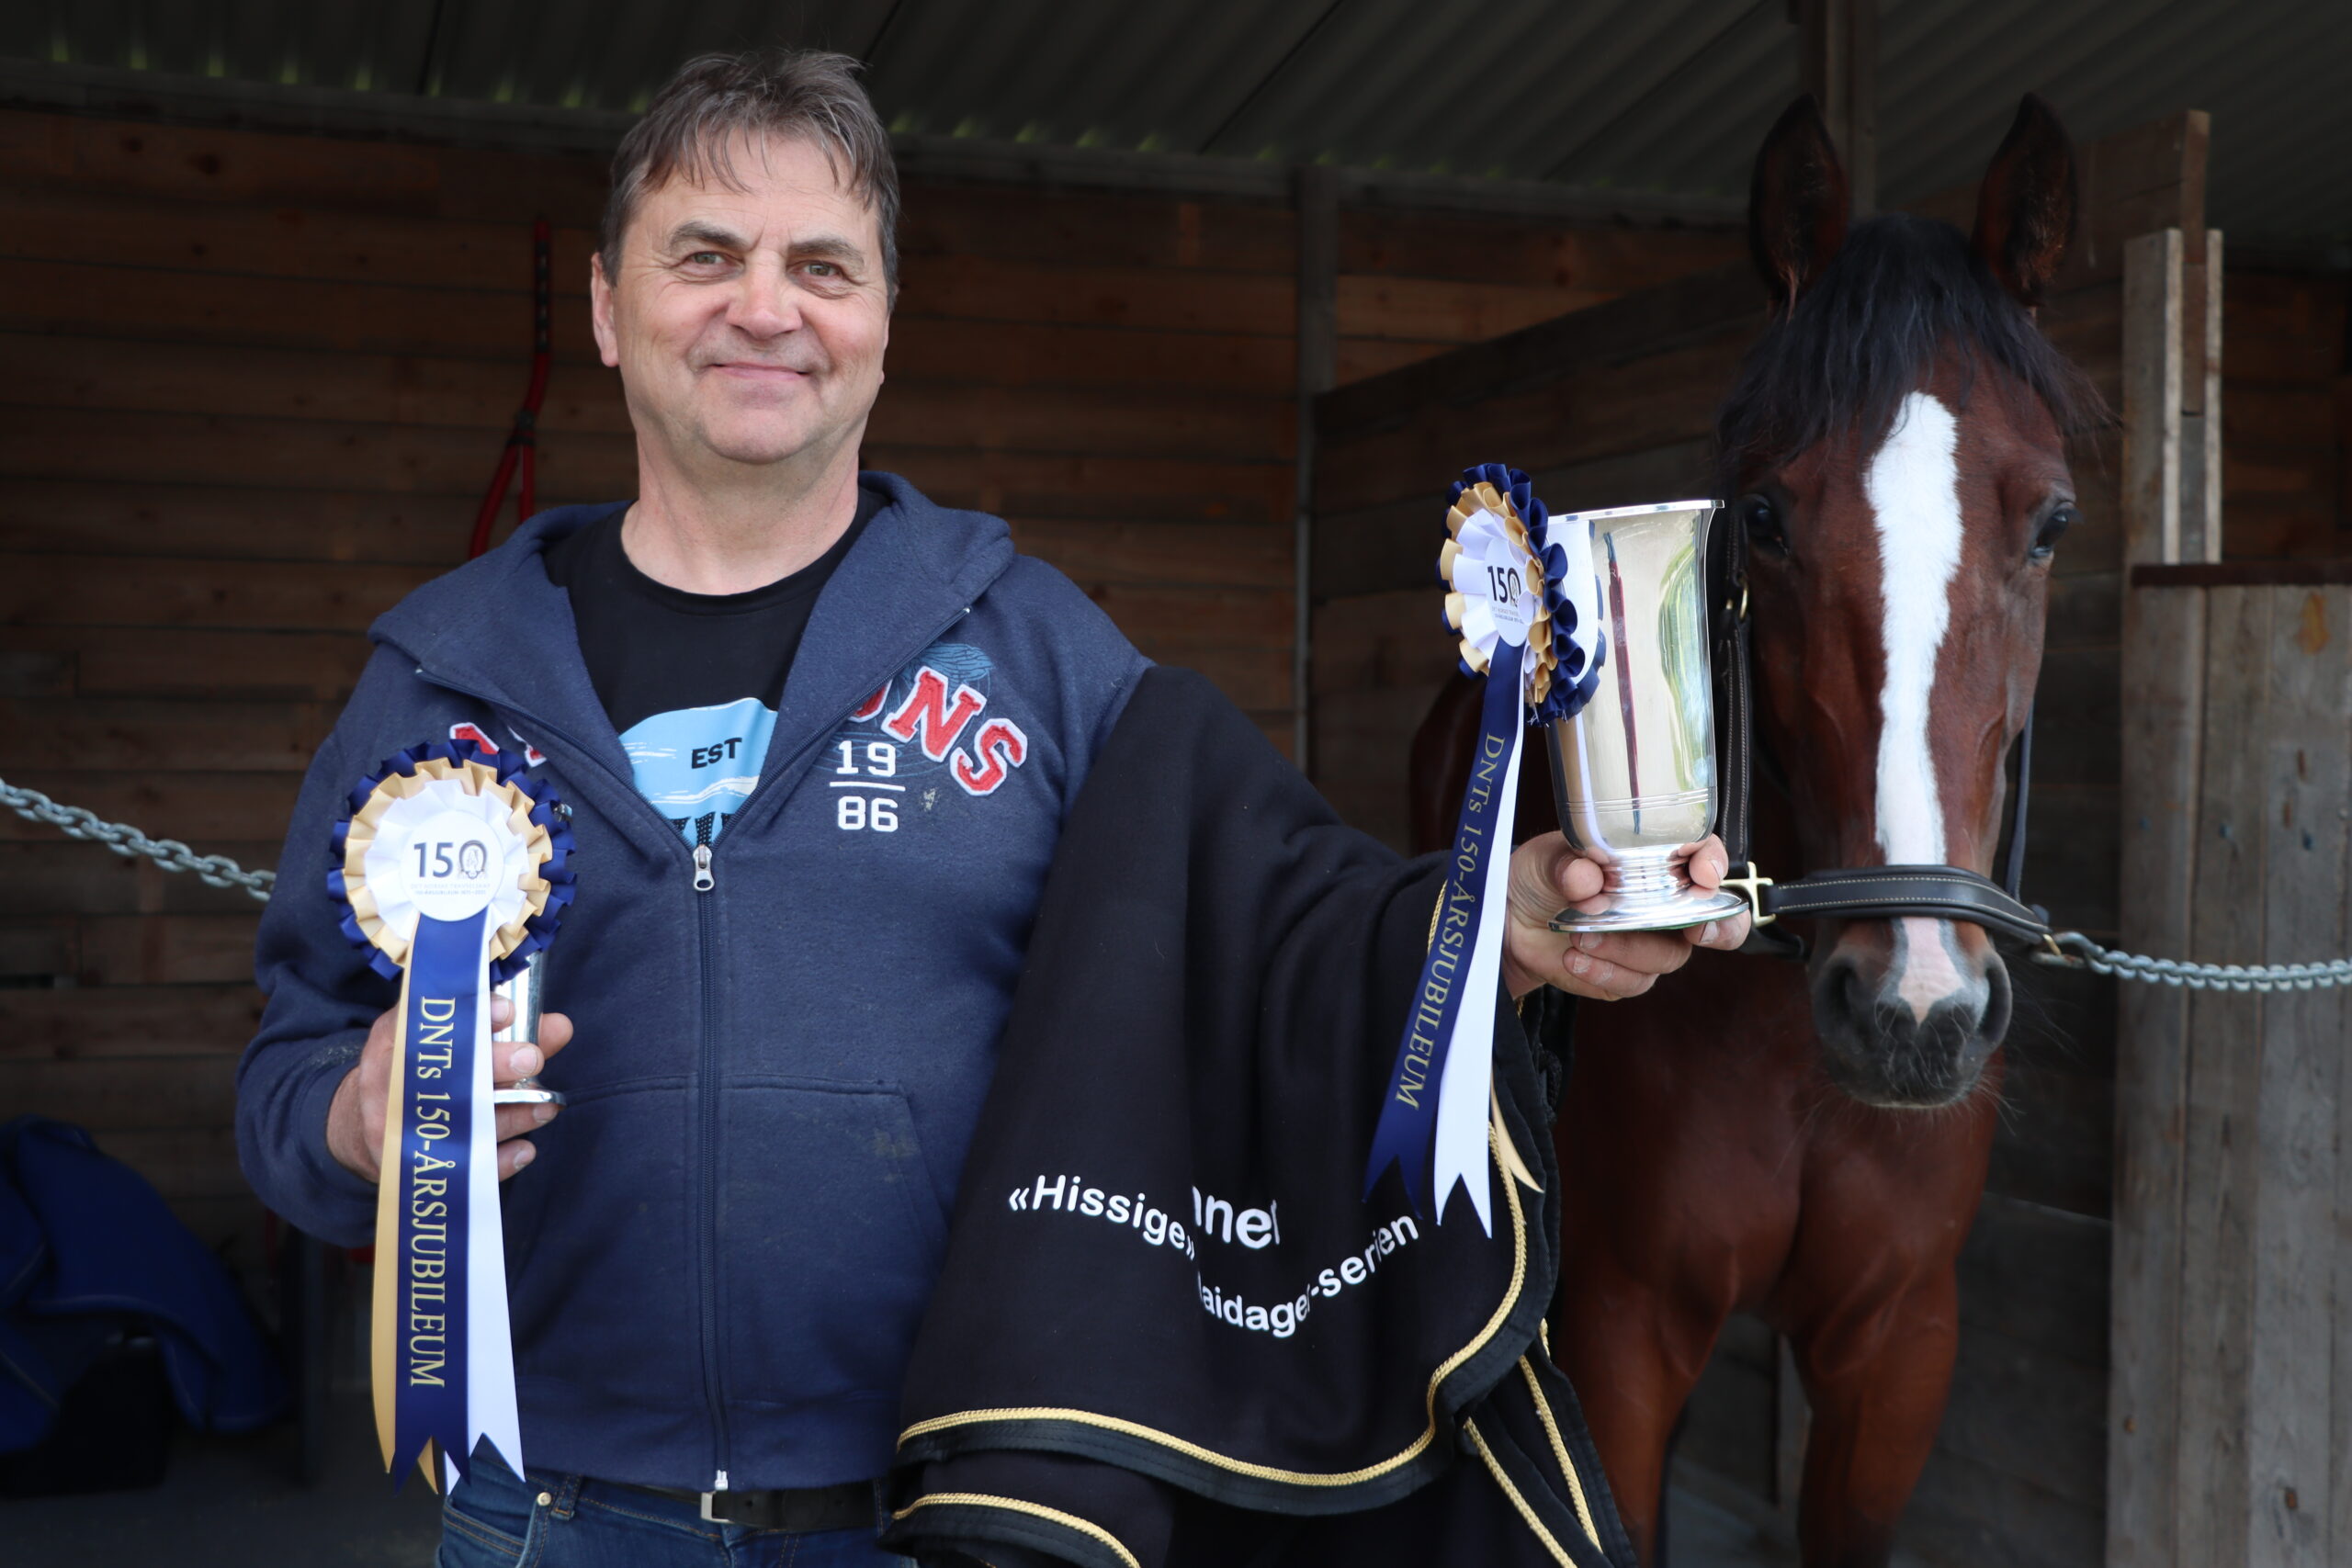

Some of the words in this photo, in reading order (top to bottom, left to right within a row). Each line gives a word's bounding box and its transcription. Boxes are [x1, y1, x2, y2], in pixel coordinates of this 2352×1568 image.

[691, 737, 742, 769] EST
[835, 739, 897, 777] 19
[1468, 732, 1506, 813] DNTs
[837, 795, 899, 832] 86
[1394, 823, 1482, 1111] 150-ÅRSJUBILEUM
[417, 996, 457, 1080] DNTs
[409, 1091, 457, 1388] 150-ÅRSJUBILEUM
